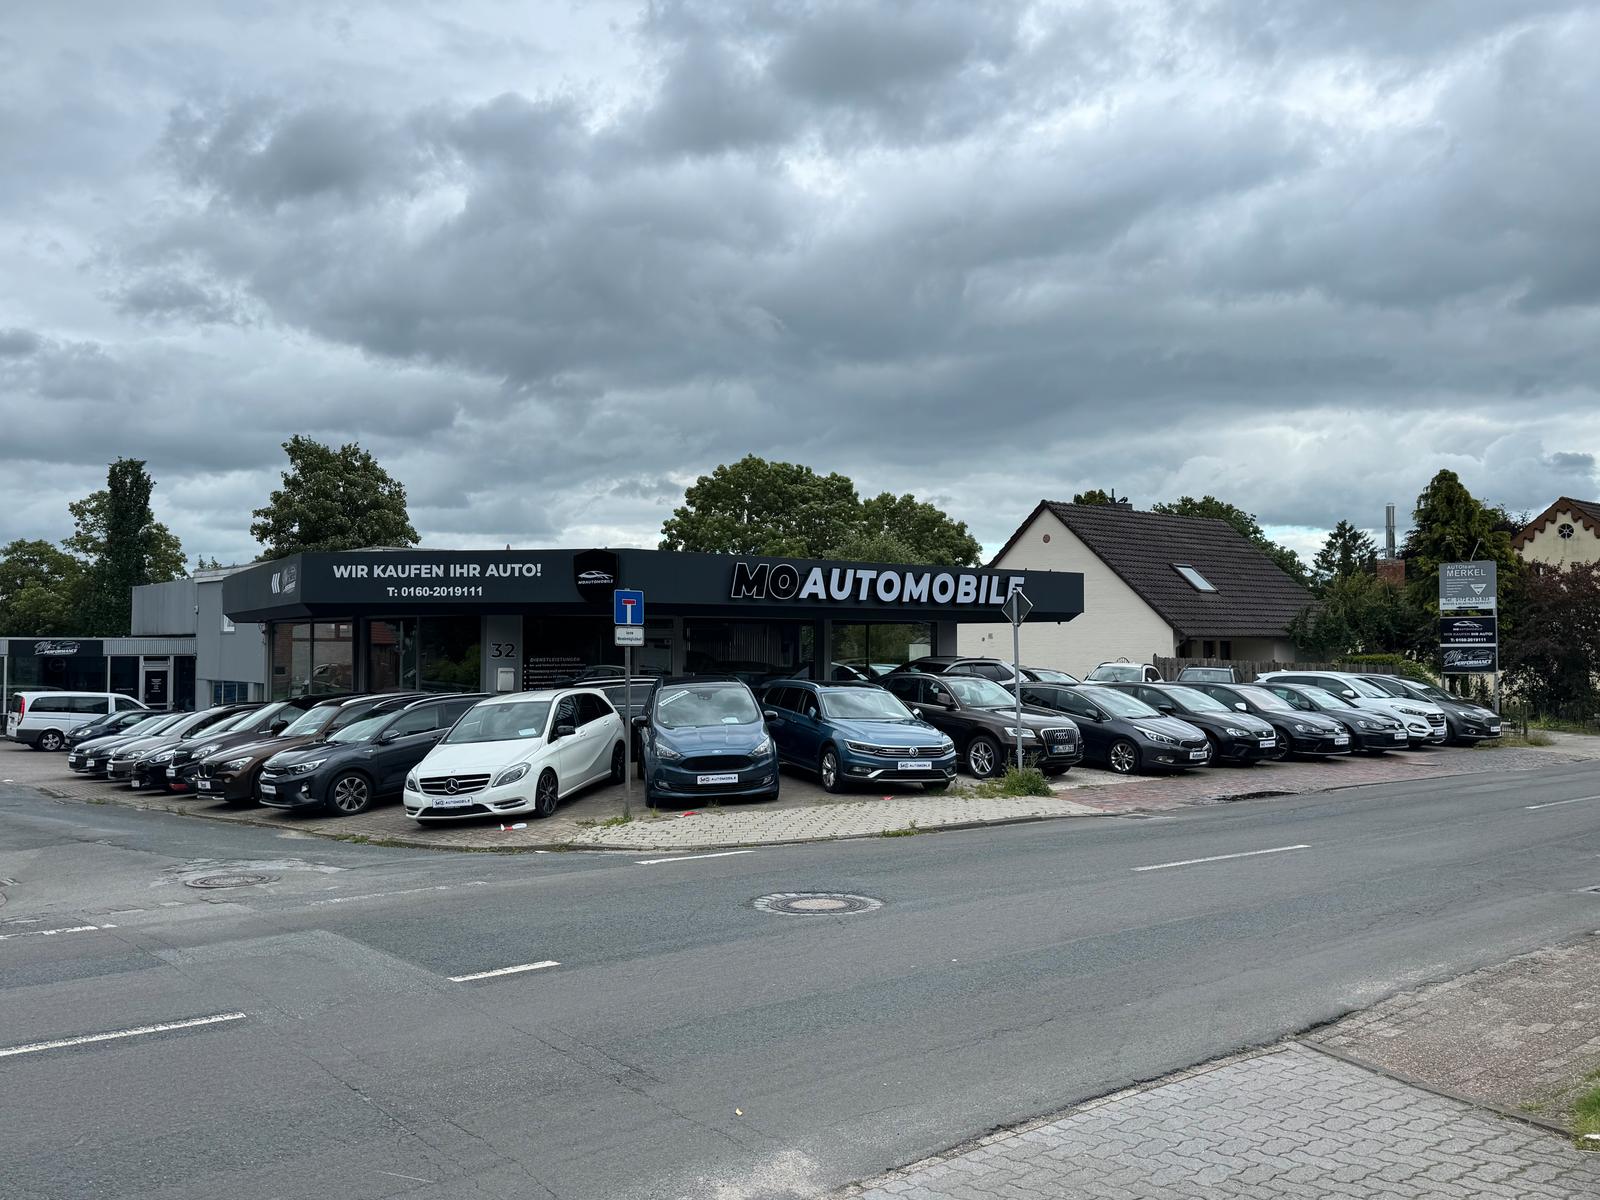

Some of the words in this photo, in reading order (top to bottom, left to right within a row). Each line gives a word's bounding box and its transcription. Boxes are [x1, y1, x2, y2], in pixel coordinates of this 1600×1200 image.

[333, 565, 368, 578] WIR
[373, 564, 444, 578] KAUFEN
[450, 564, 480, 577] IHR
[485, 563, 542, 577] AUTO!
[1446, 569, 1487, 577] MERKEL
[387, 587, 398, 597] T:
[401, 586, 483, 597] 0160-2019111
[491, 643, 516, 658] 32
